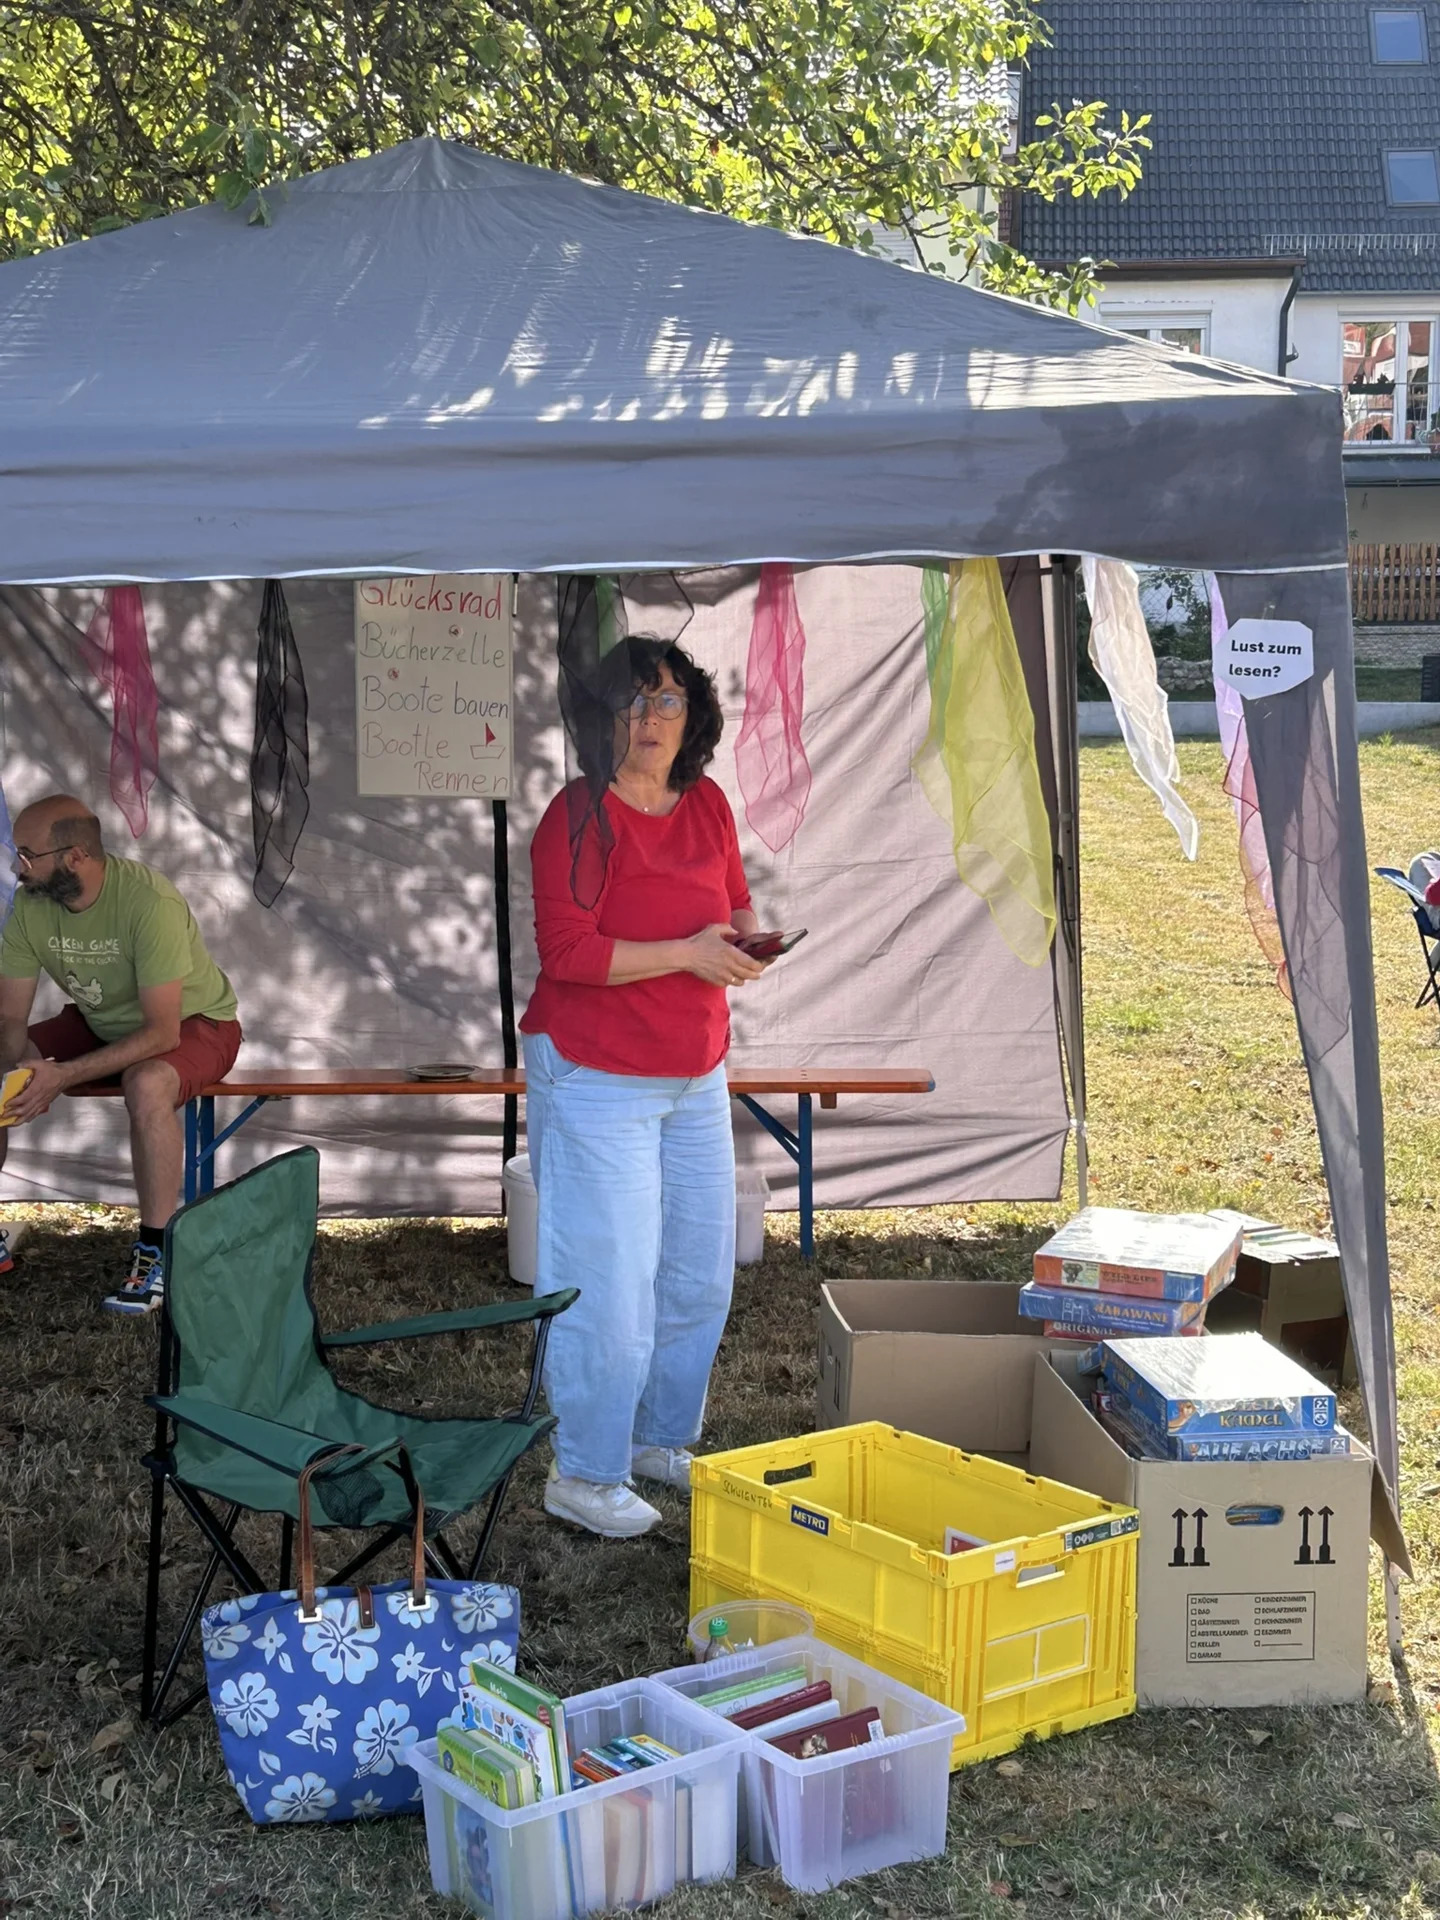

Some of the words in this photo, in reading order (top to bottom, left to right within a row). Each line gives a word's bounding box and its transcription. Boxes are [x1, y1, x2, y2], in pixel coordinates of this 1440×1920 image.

[360, 575, 502, 620] Glücksrad
[360, 621, 506, 668] Bücherzelle
[1231, 640, 1264, 653] Lust
[1268, 645, 1302, 655] zum
[1229, 664, 1281, 678] lesen?
[362, 675, 443, 713] Boote
[362, 721, 450, 759] Bootle
[413, 761, 508, 794] Rennen
[1053, 1321, 1117, 1337] ORIGINAL
[1194, 1441, 1243, 1461] AUF
[1244, 1439, 1324, 1461] ACHSE
[793, 1509, 826, 1531] METRO
